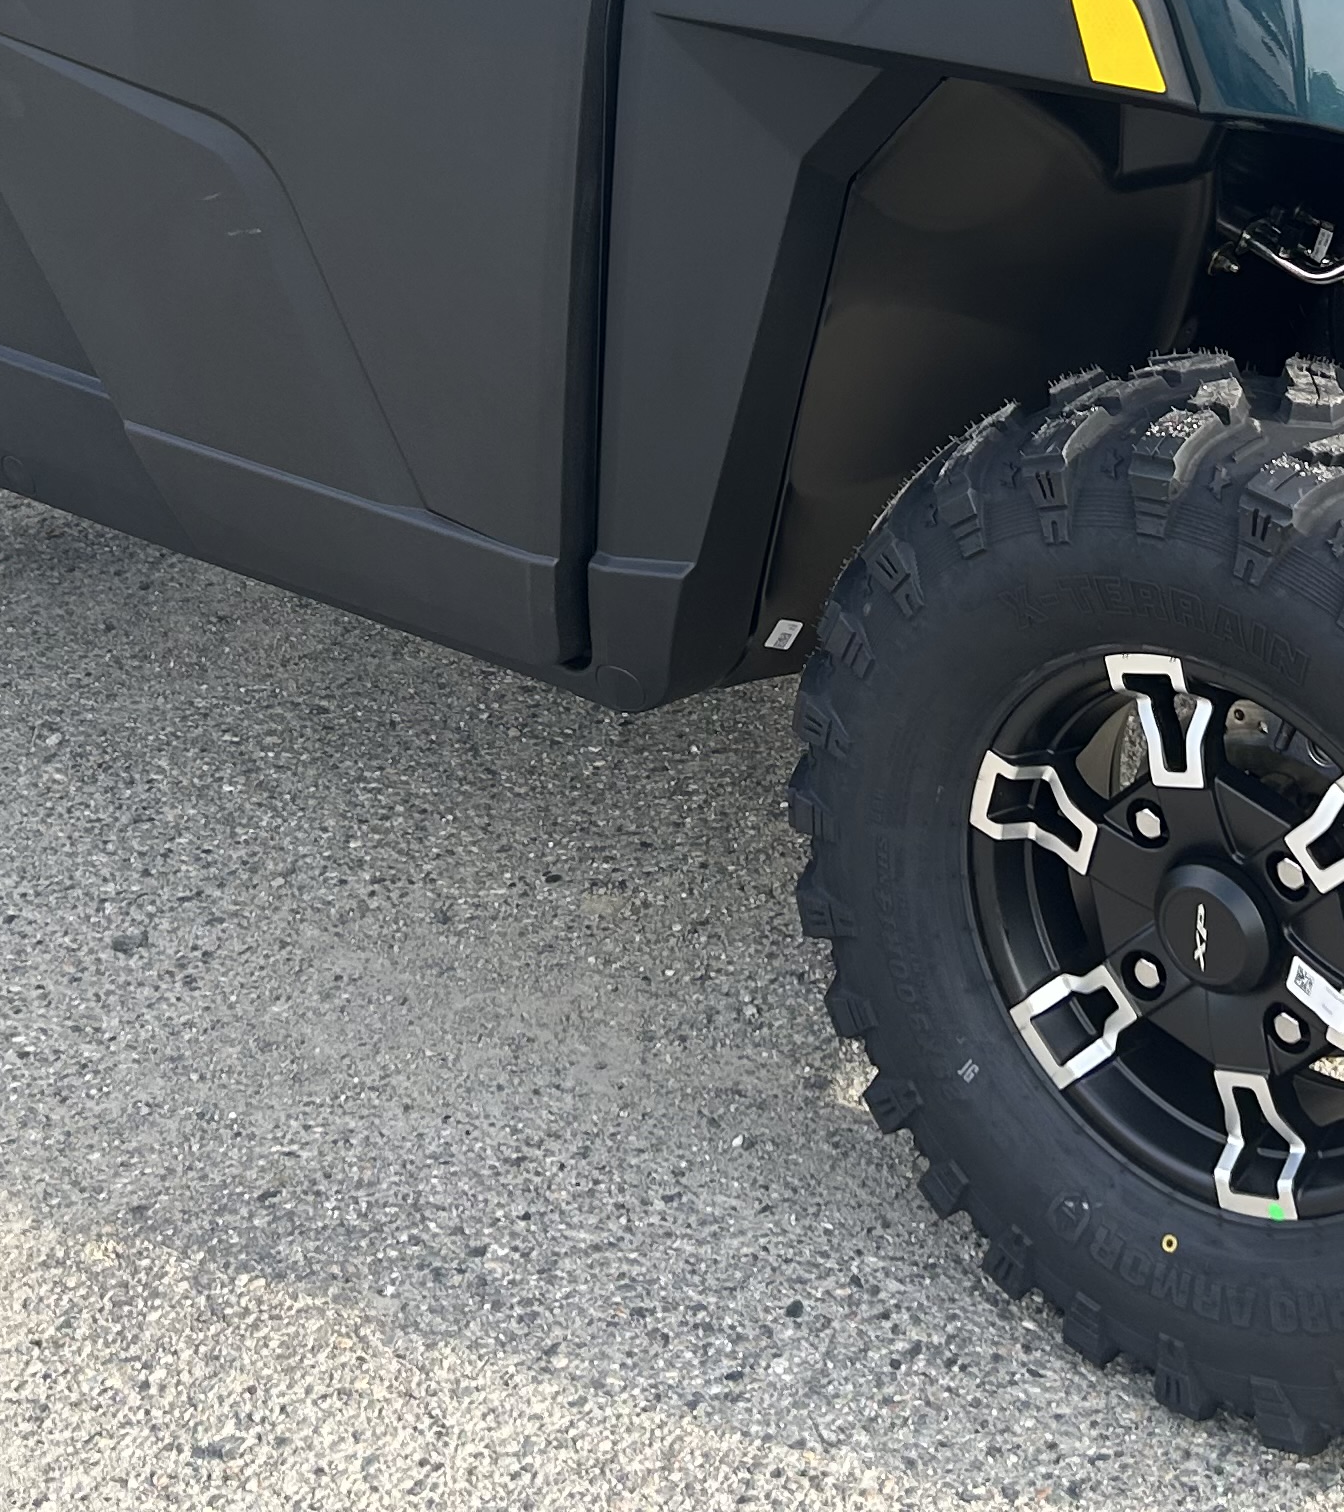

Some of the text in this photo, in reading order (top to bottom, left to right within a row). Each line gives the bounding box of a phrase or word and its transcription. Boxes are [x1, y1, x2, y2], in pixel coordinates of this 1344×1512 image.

[998, 574, 1313, 688] X-TERRAIN
[1193, 903, 1208, 973] XP
[1086, 1221, 1258, 1330] ARMOR
